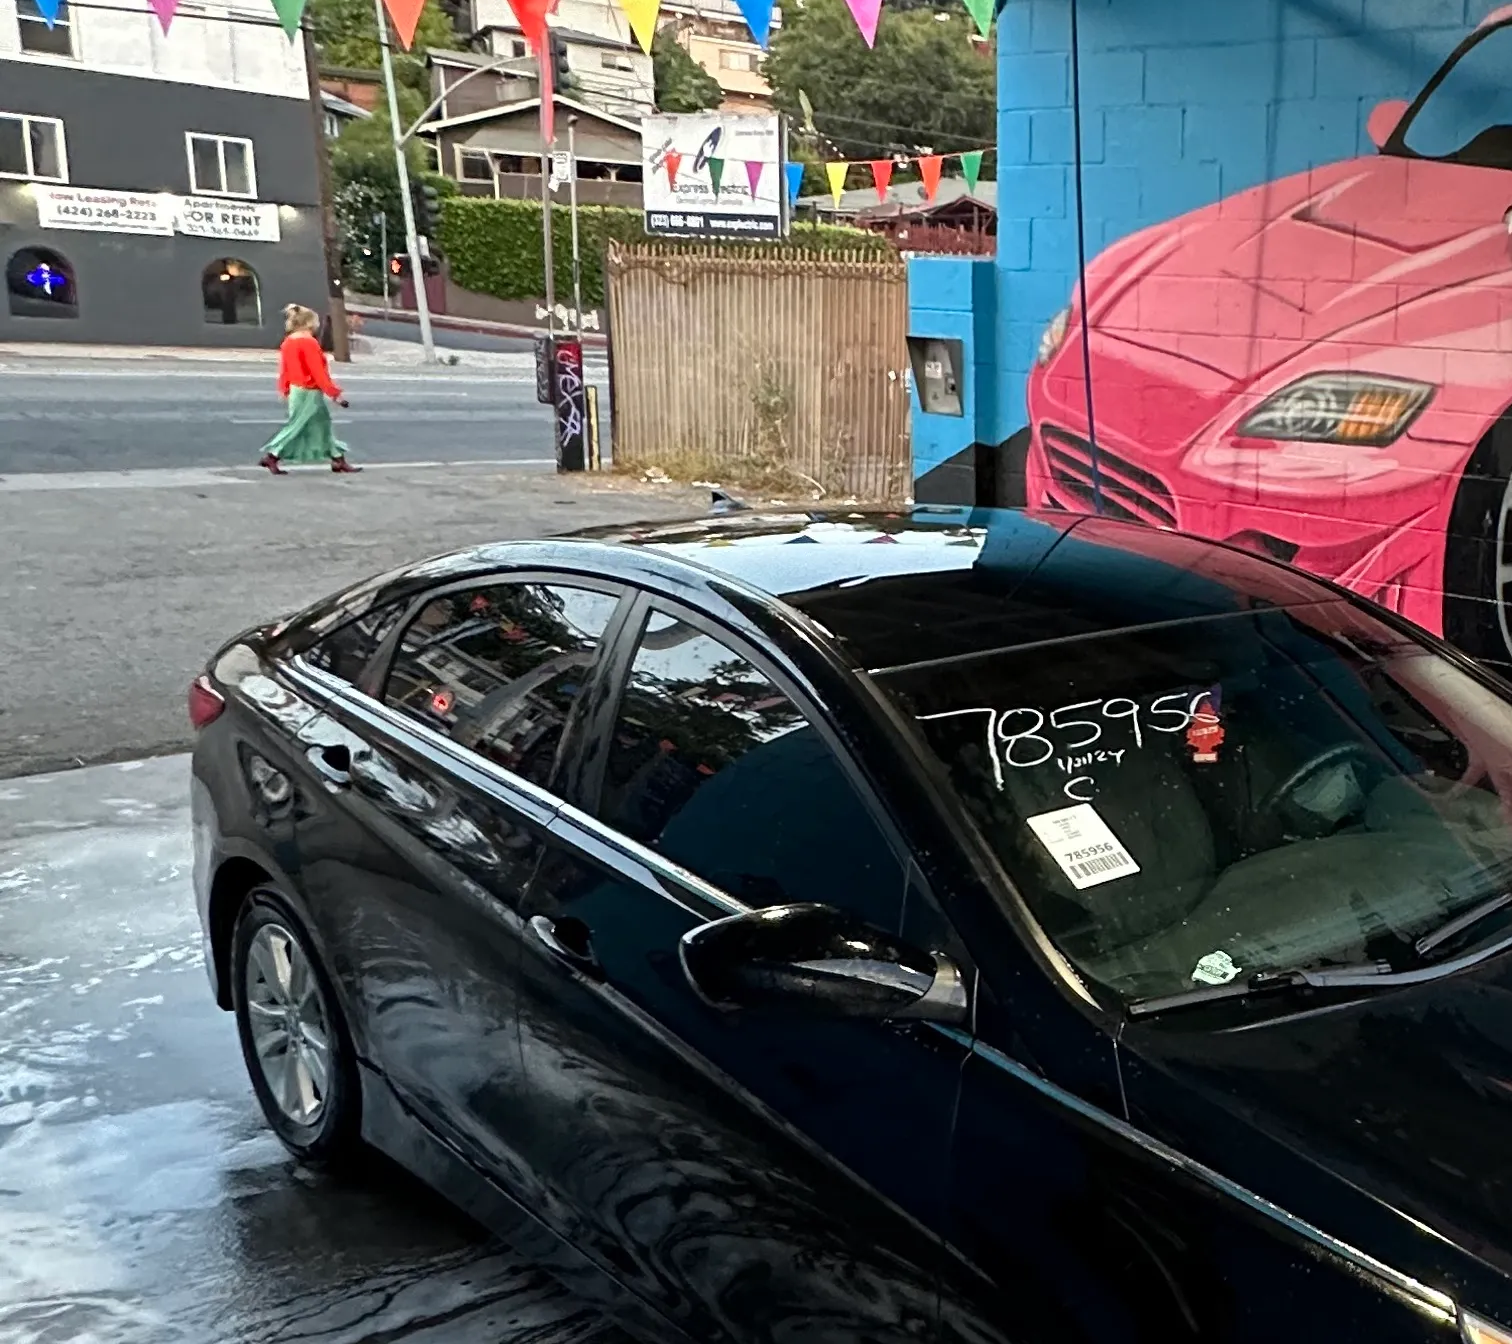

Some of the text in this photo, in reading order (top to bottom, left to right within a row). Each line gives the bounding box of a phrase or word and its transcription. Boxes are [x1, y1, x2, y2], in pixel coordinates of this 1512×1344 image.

[77, 192, 127, 207] Leasing
[57, 204, 92, 217] (424)
[221, 212, 261, 226] RENT
[915, 691, 1220, 792] 785956
[1063, 776, 1095, 801] C
[1064, 842, 1113, 862] 785956
